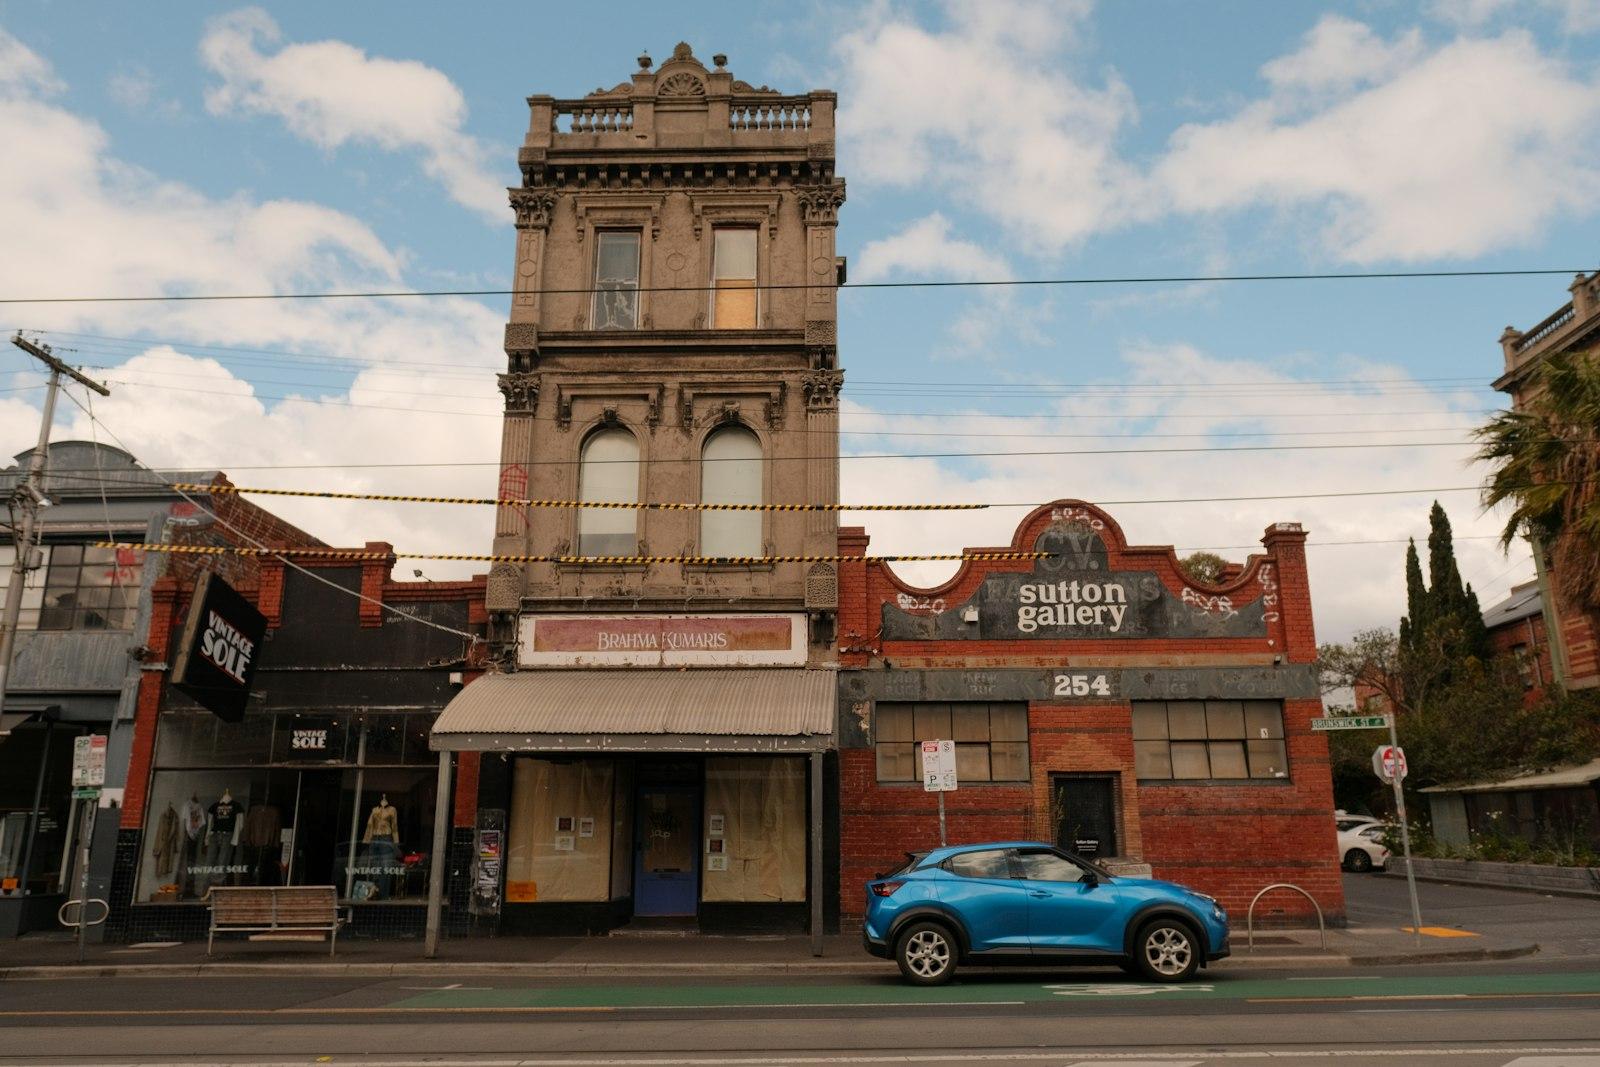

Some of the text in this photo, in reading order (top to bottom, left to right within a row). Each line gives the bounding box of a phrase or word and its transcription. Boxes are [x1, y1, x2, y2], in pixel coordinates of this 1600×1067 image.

[1019, 580, 1127, 604] sutton
[1017, 603, 1128, 633] gallery
[208, 609, 254, 659] VINTAGE
[597, 631, 728, 650] BRAHMA KUMARIS
[200, 628, 250, 684] SOLE
[1054, 674, 1111, 696] 254
[1312, 718, 1356, 730] BRUNSWICK
[1360, 718, 1372, 728] ST
[293, 729, 328, 738] VINTAGE
[292, 737, 327, 749] SOLE
[930, 775, 937, 784] P
[187, 864, 249, 875] VINTAGE SOLE
[344, 866, 406, 876] VINTAGE SOLE
